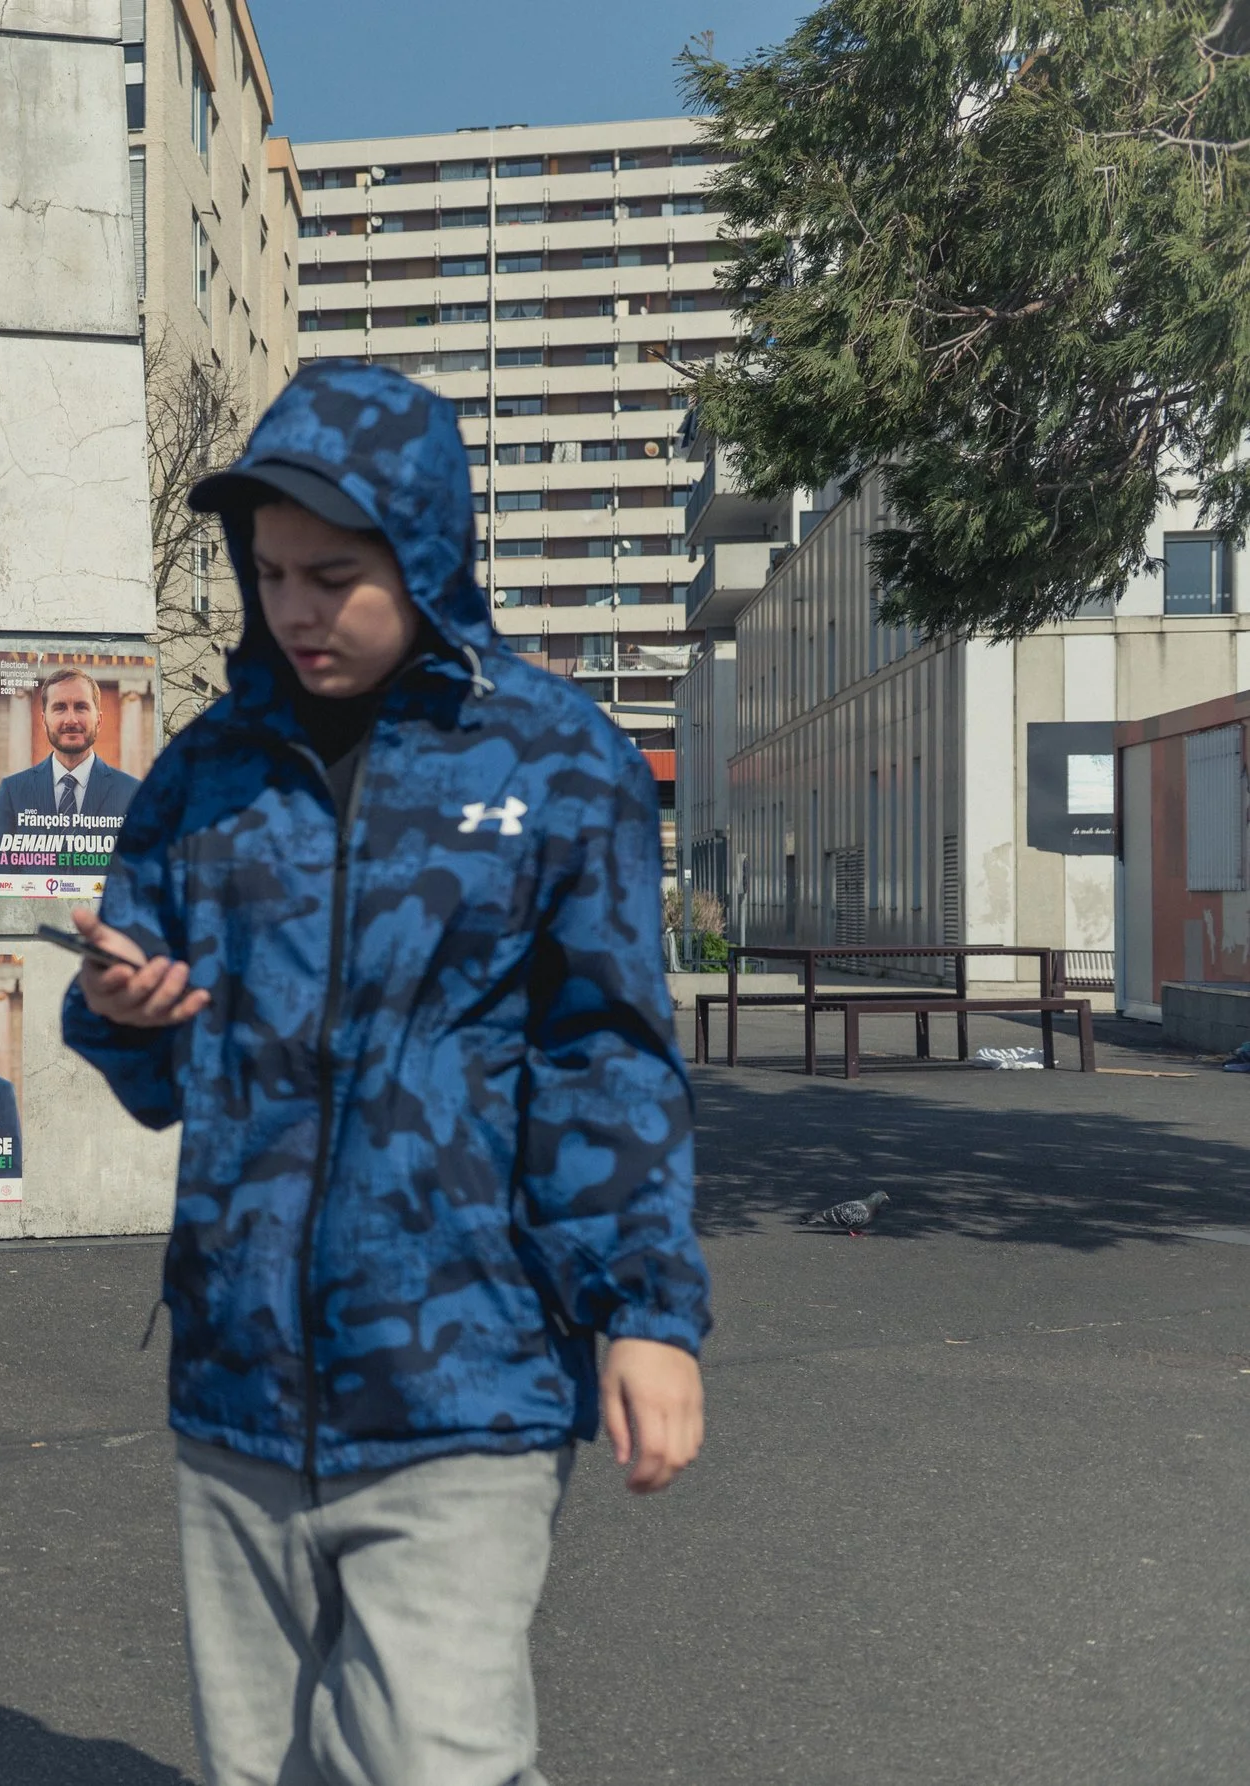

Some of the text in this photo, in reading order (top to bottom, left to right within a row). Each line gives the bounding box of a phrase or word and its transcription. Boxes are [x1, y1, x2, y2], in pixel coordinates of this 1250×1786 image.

[0, 659, 29, 669] Élections
[0, 670, 37, 678] municipales
[0, 687, 16, 695] 2026
[17, 812, 126, 829] François Piquema
[0, 834, 118, 853] DEMAIN TOULO
[0, 851, 112, 867] À GAUCHE ET ÉCOLO
